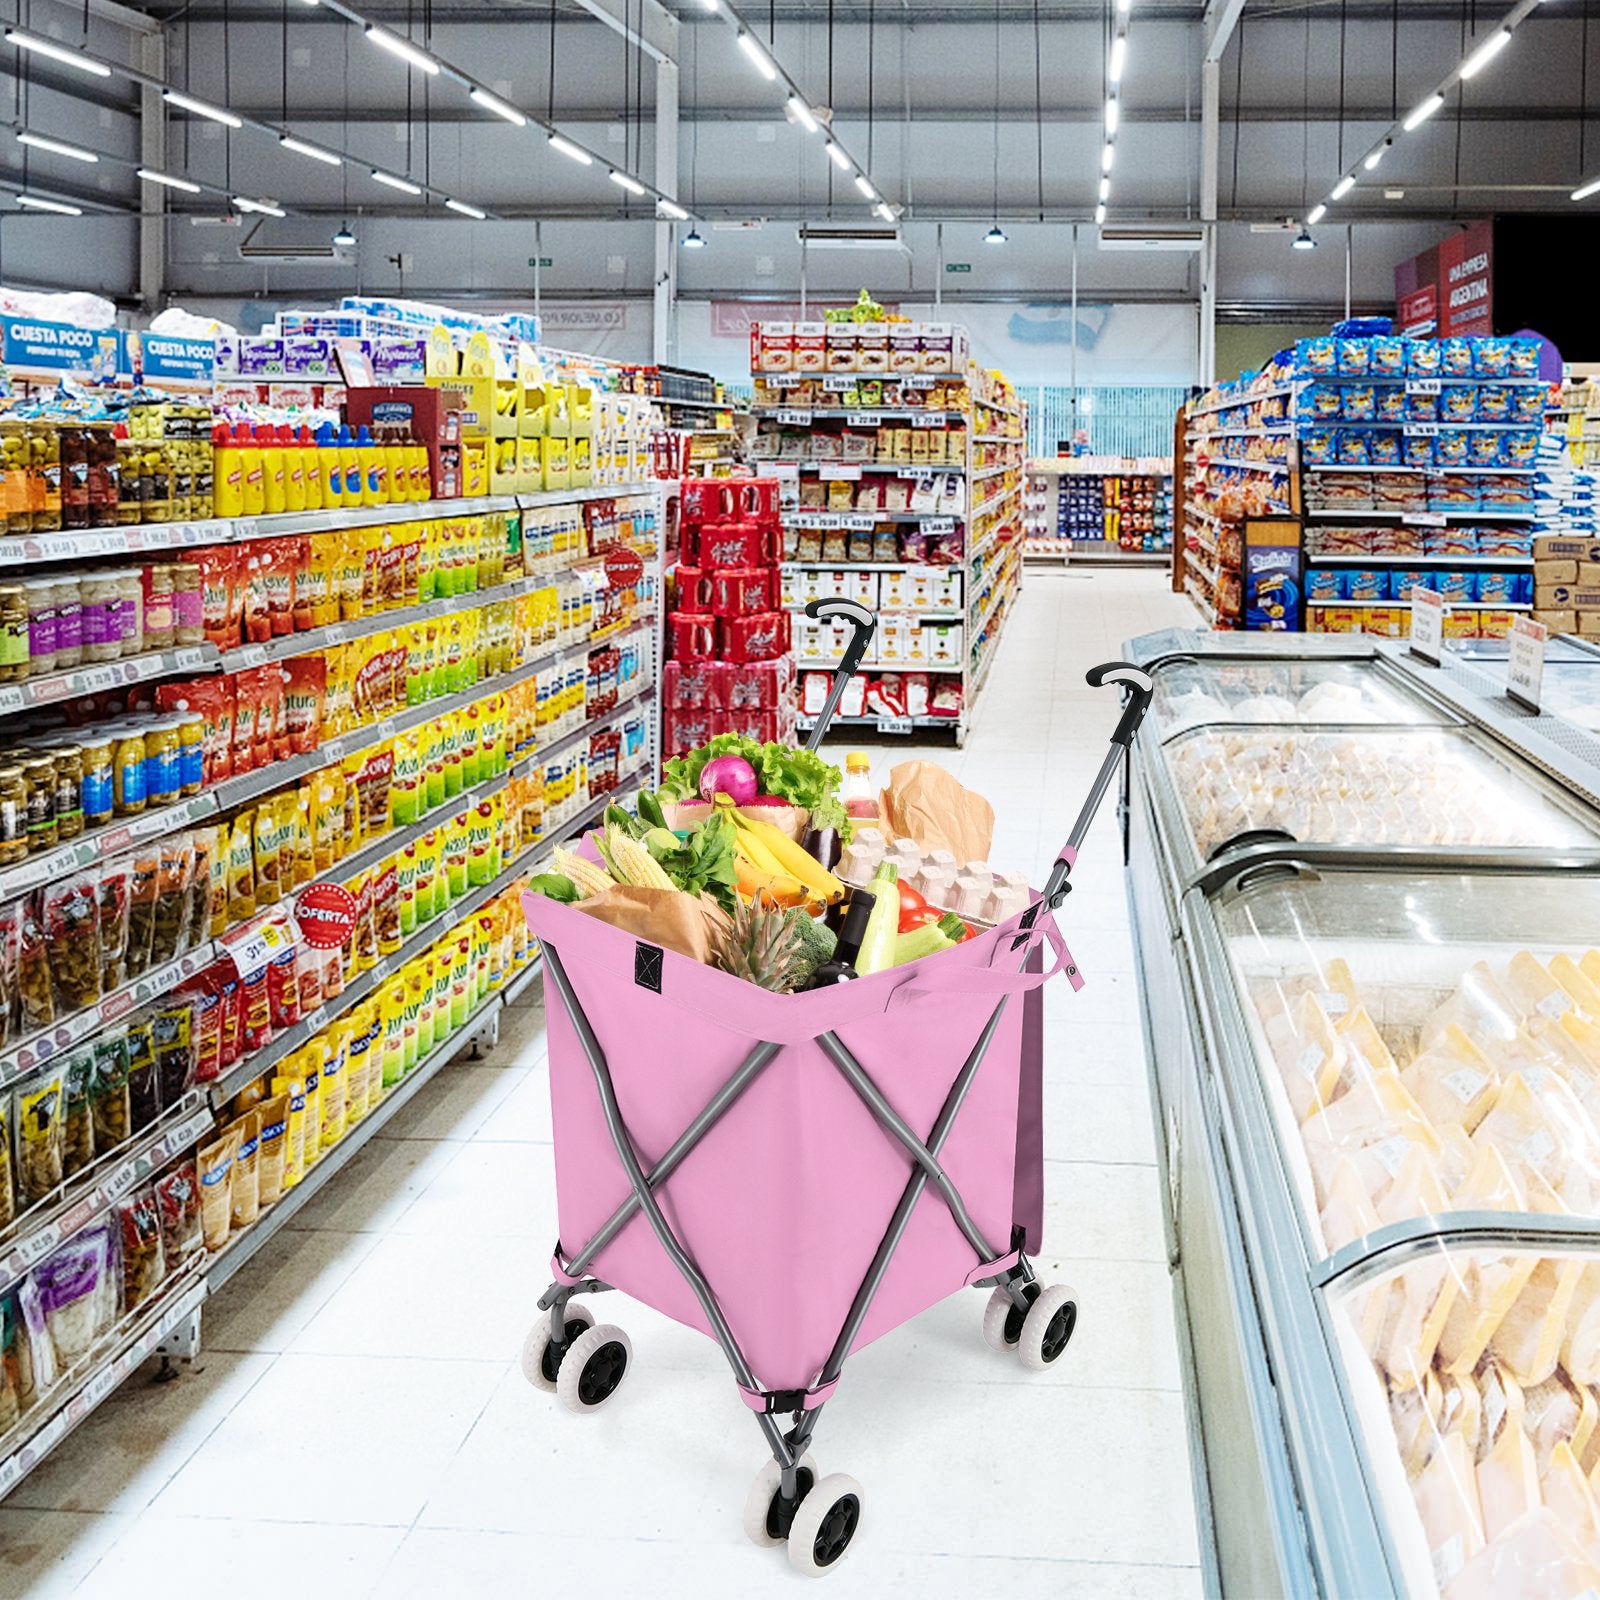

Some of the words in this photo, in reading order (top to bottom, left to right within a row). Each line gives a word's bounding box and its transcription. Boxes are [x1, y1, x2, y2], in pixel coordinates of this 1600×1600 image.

[10, 323, 58, 344] CUESTA
[59, 329, 93, 348] POCO
[148, 340, 185, 357] CUESTA
[187, 345, 213, 360] POCO
[300, 906, 350, 924] OFERTA
